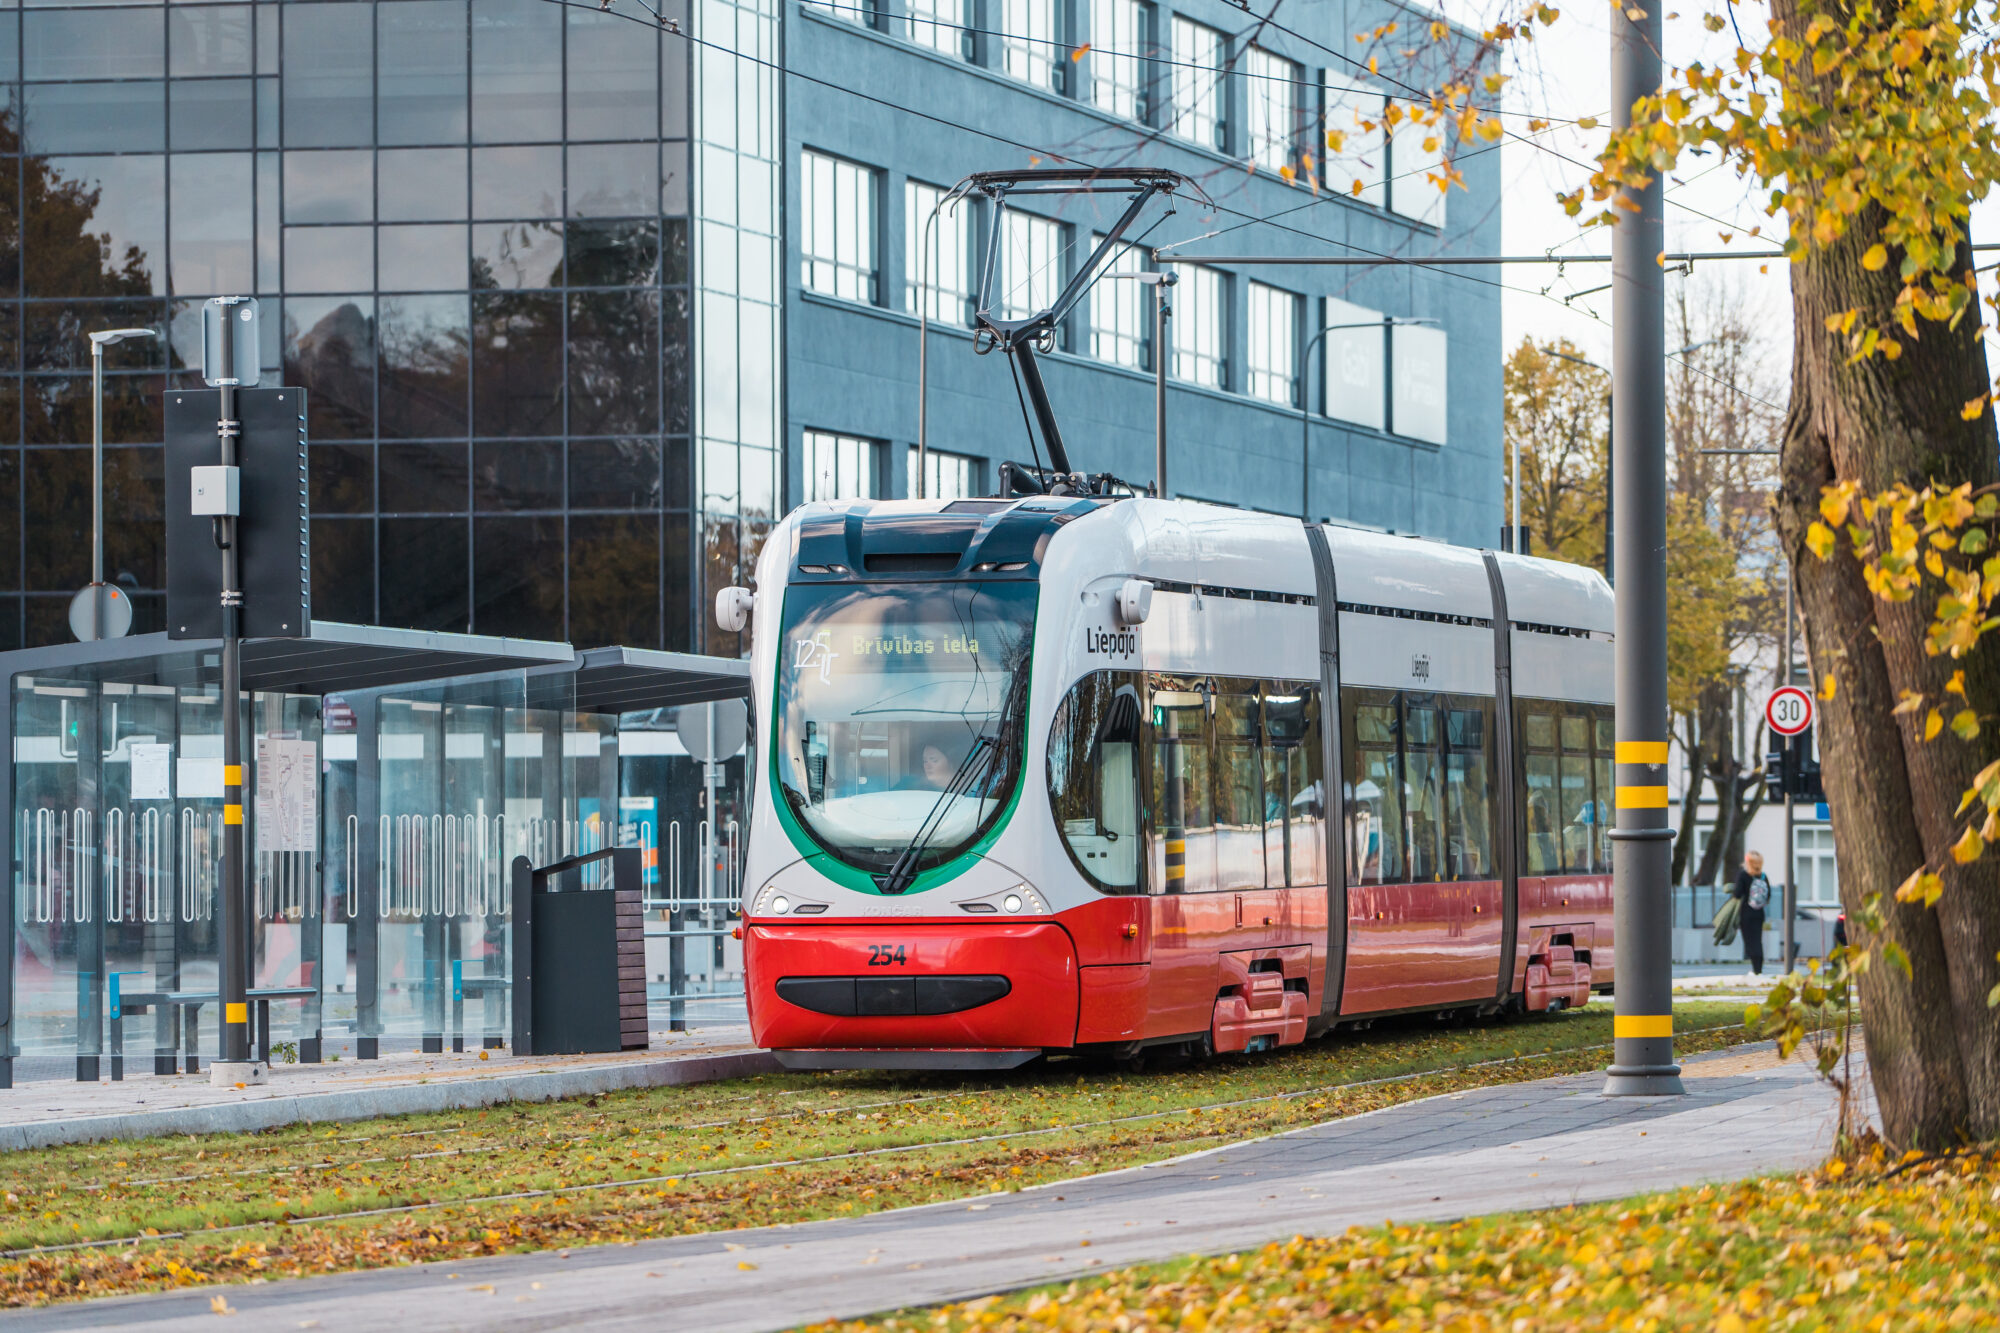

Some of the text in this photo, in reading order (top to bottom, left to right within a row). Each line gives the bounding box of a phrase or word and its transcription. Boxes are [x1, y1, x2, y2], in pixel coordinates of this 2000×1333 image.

[943, 633, 979, 654] iela
[1778, 700, 1800, 721] 30
[868, 945, 907, 966] 254
